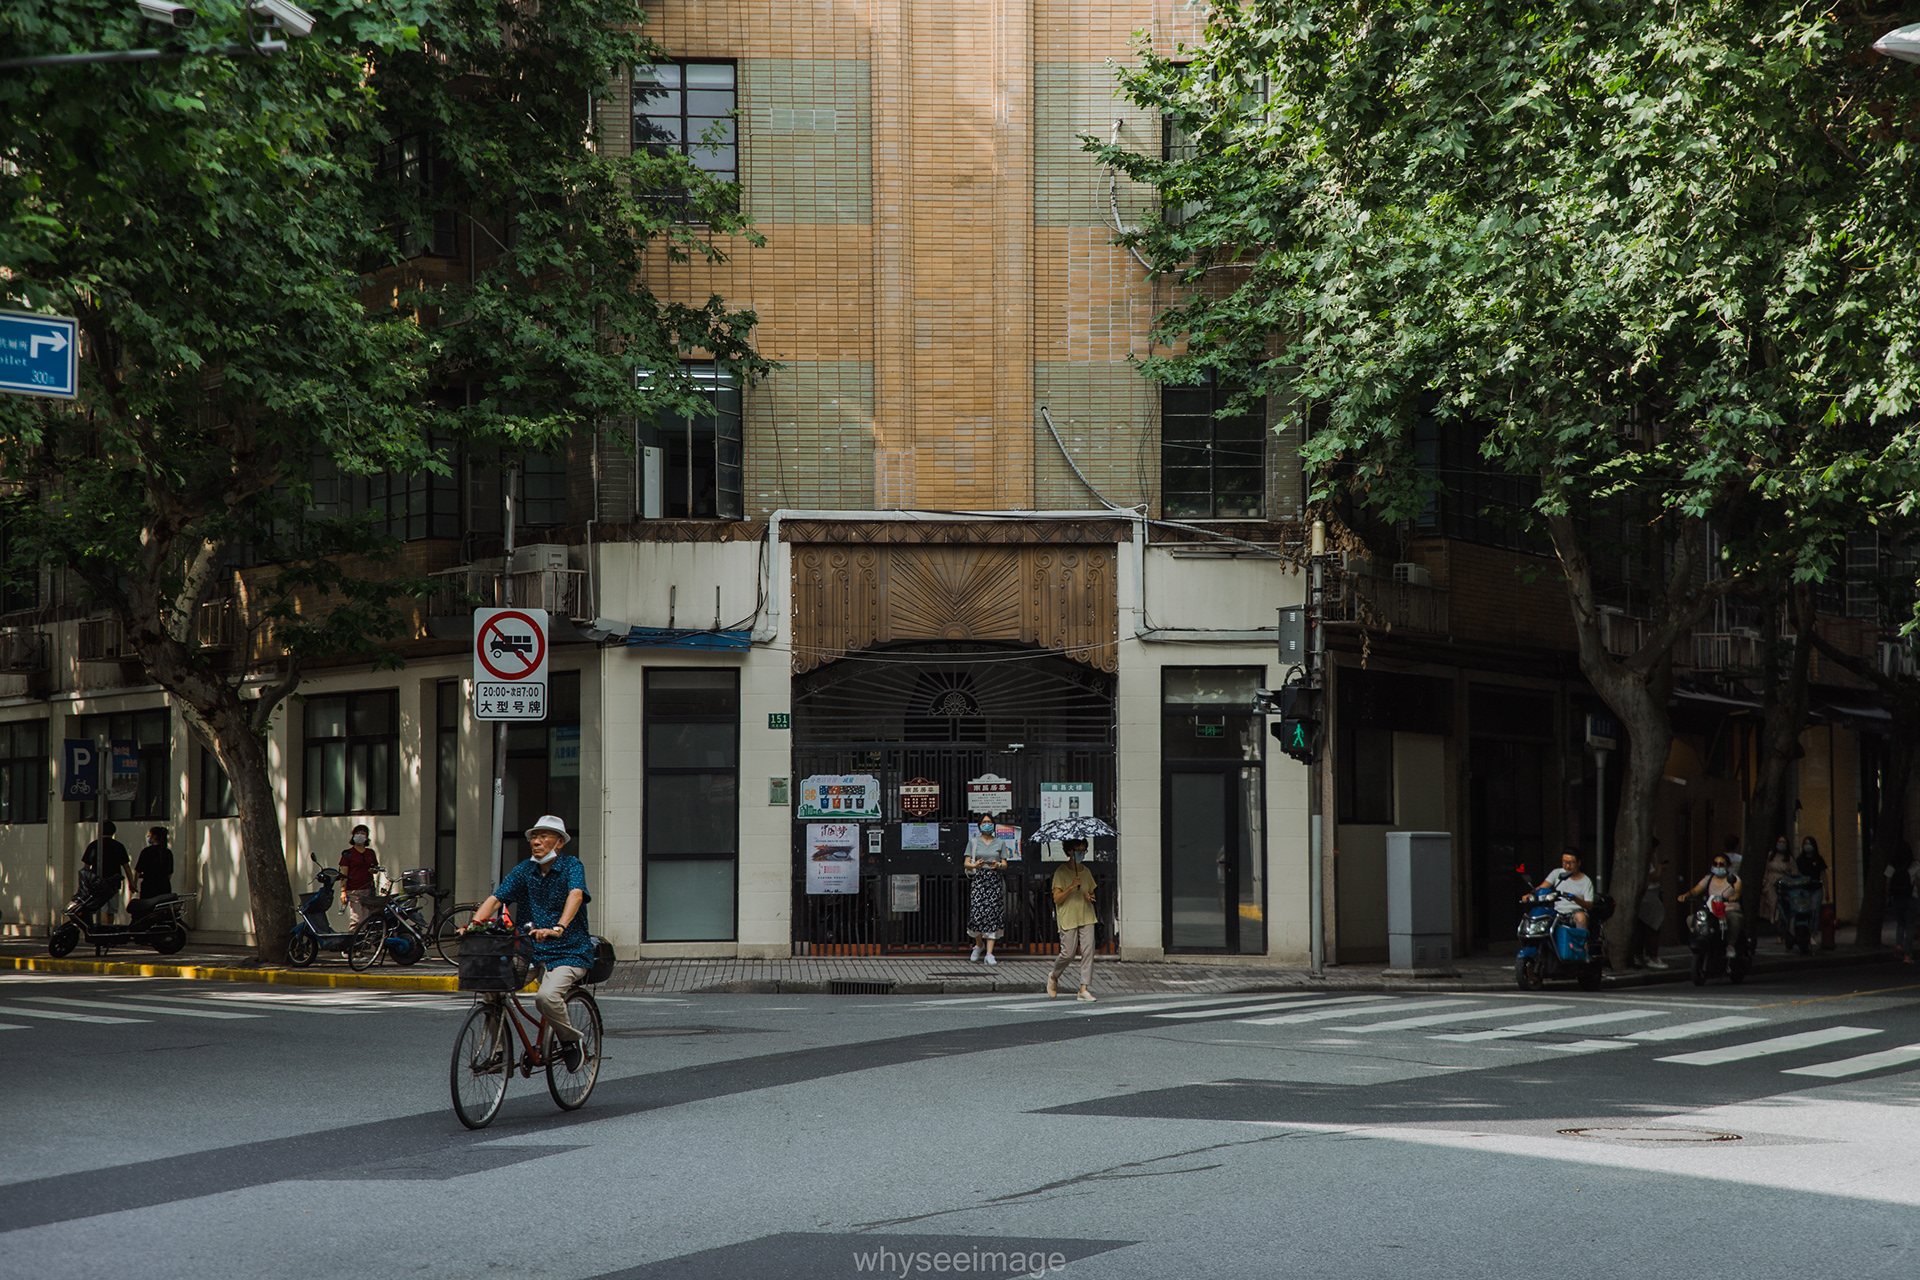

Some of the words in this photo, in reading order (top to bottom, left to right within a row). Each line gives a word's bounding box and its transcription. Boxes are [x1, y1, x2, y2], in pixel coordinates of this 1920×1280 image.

[483, 686, 539, 697] 20:00-次日7:00
[480, 700, 541, 713] 大型号牌
[771, 715, 788, 724] 151
[73, 748, 91, 775] P
